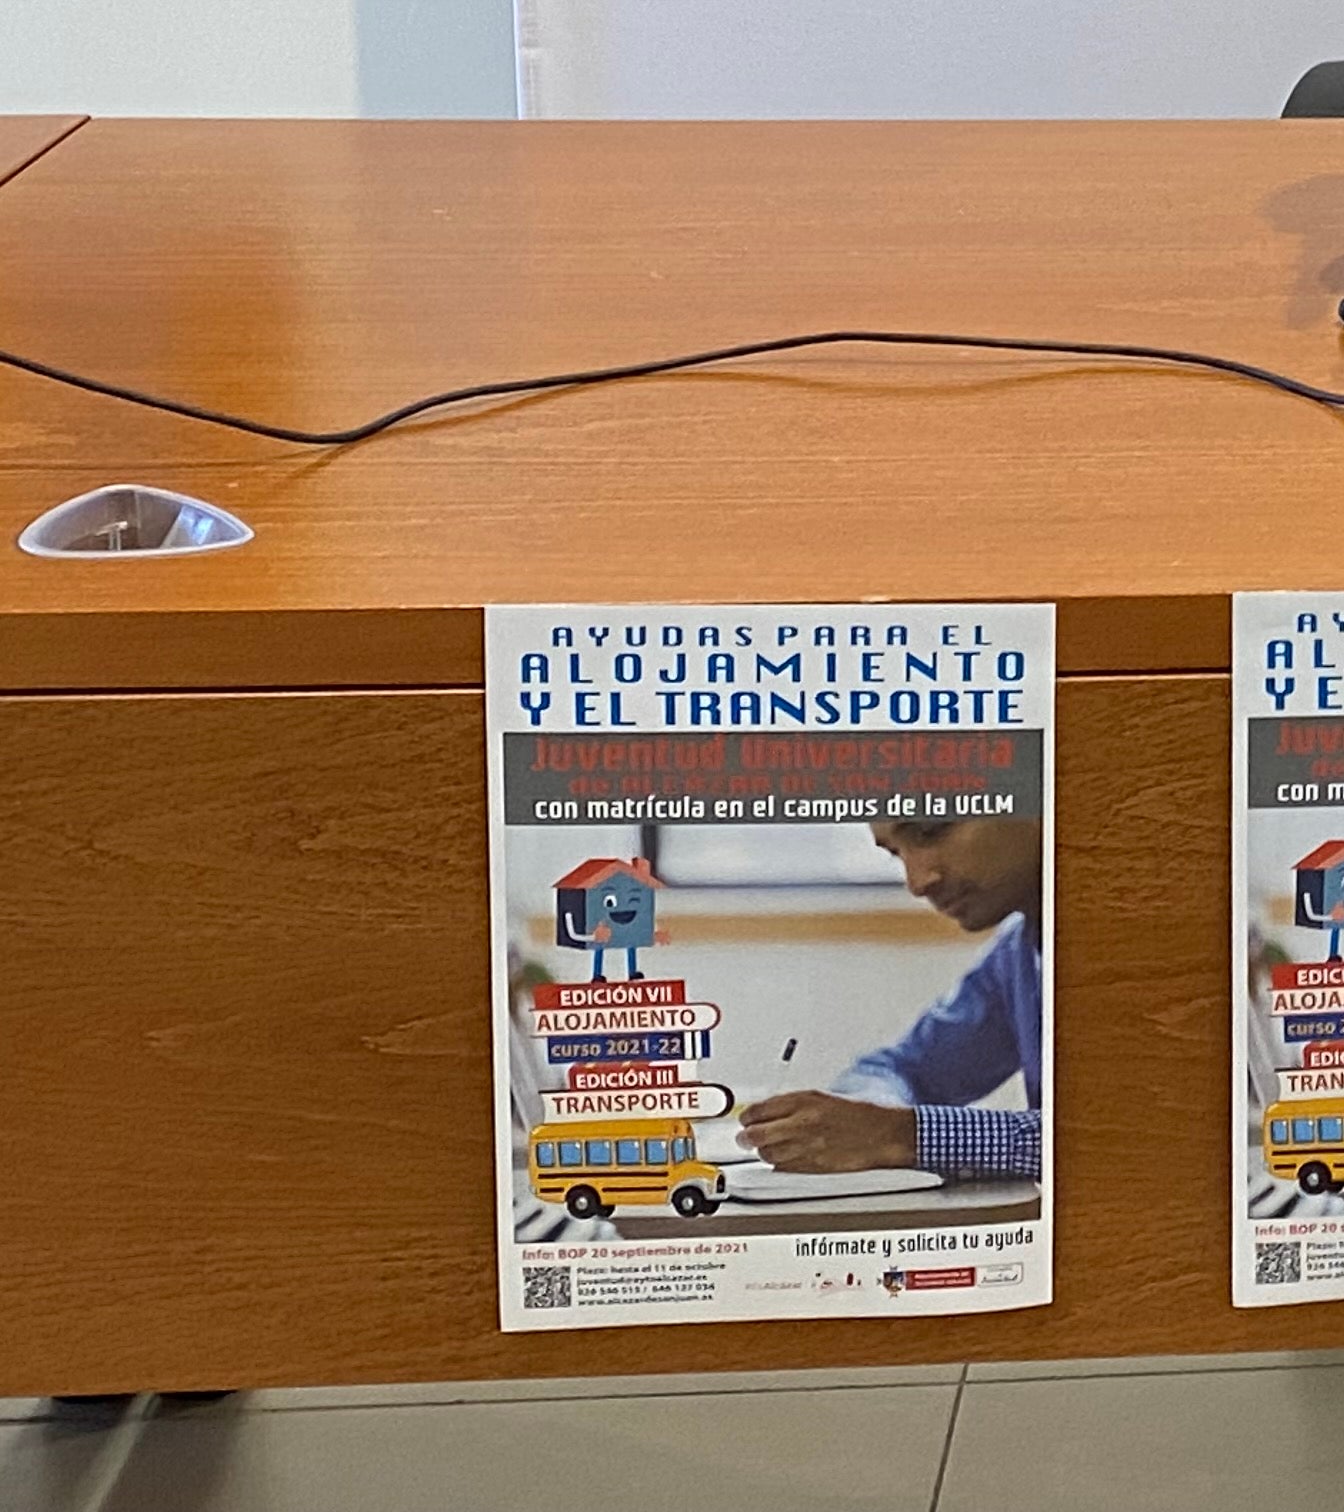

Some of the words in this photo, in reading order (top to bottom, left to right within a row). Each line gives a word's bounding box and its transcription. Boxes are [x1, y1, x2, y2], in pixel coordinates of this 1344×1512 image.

[552, 626, 753, 646] AYUDAS
[778, 625, 907, 646] PARA
[942, 625, 992, 645] EL
[521, 651, 1025, 684] ALOJAMIENTO
[1265, 677, 1295, 711] Y
[520, 691, 551, 726] Y
[575, 691, 635, 726] EL
[656, 689, 1024, 725] TRANSPORTE
[1277, 781, 1318, 802] con
[535, 798, 578, 819] con
[587, 794, 705, 819] matrícula
[715, 799, 743, 818] en
[753, 794, 775, 818] el
[783, 796, 877, 822] campus
[887, 794, 917, 816] de
[924, 794, 946, 815] la
[955, 794, 1014, 814] UCLM
[560, 986, 642, 1006] EDICIÓN
[647, 986, 672, 1003] VII
[537, 1008, 695, 1031] ALOJAMIENTO
[575, 1068, 652, 1089] EDICIÓN
[657, 1068, 674, 1085] III
[552, 1091, 699, 1115] TRANSPORTE
[796, 1234, 876, 1258] infórmate
[882, 1238, 891, 1254] y
[897, 1231, 957, 1253] solicita
[963, 1231, 978, 1250] tu
[985, 1227, 1034, 1251] ayuda
